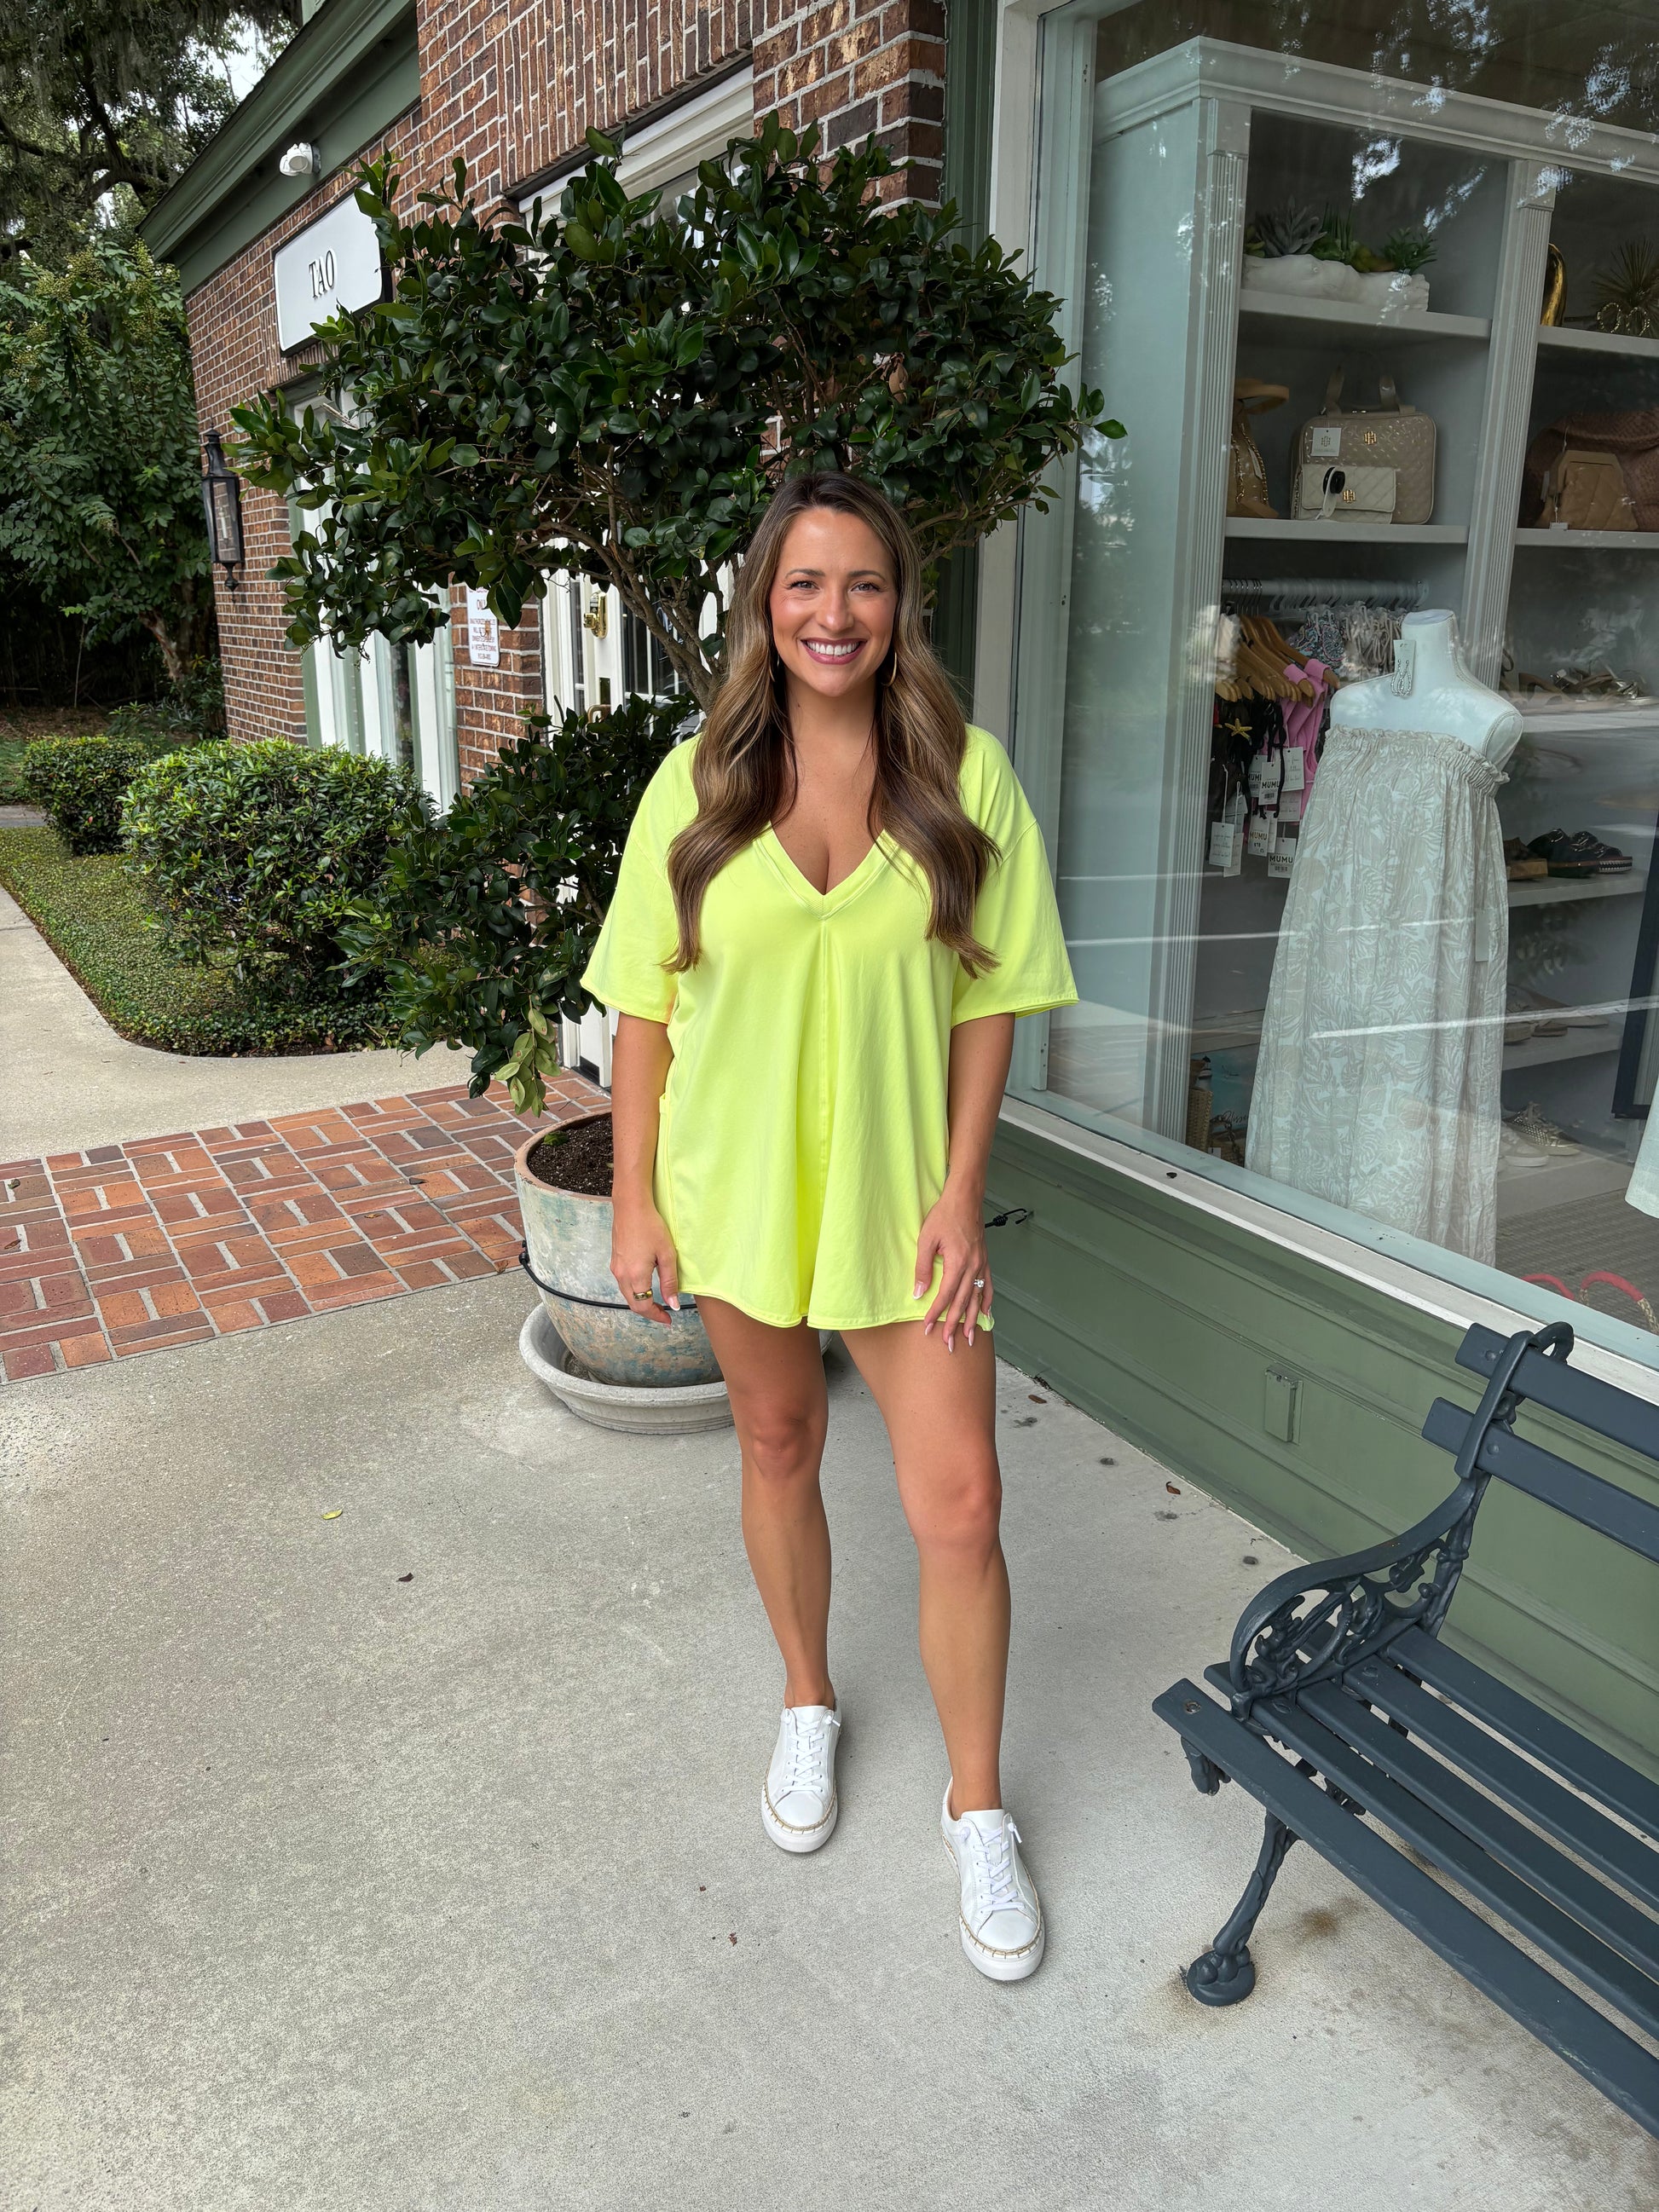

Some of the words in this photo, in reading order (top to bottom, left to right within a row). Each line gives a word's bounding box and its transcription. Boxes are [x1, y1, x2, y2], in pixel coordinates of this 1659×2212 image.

[309, 250, 335, 298] TAO
[1250, 831, 1268, 840] MUMU
[1269, 855, 1293, 863] MUMU
